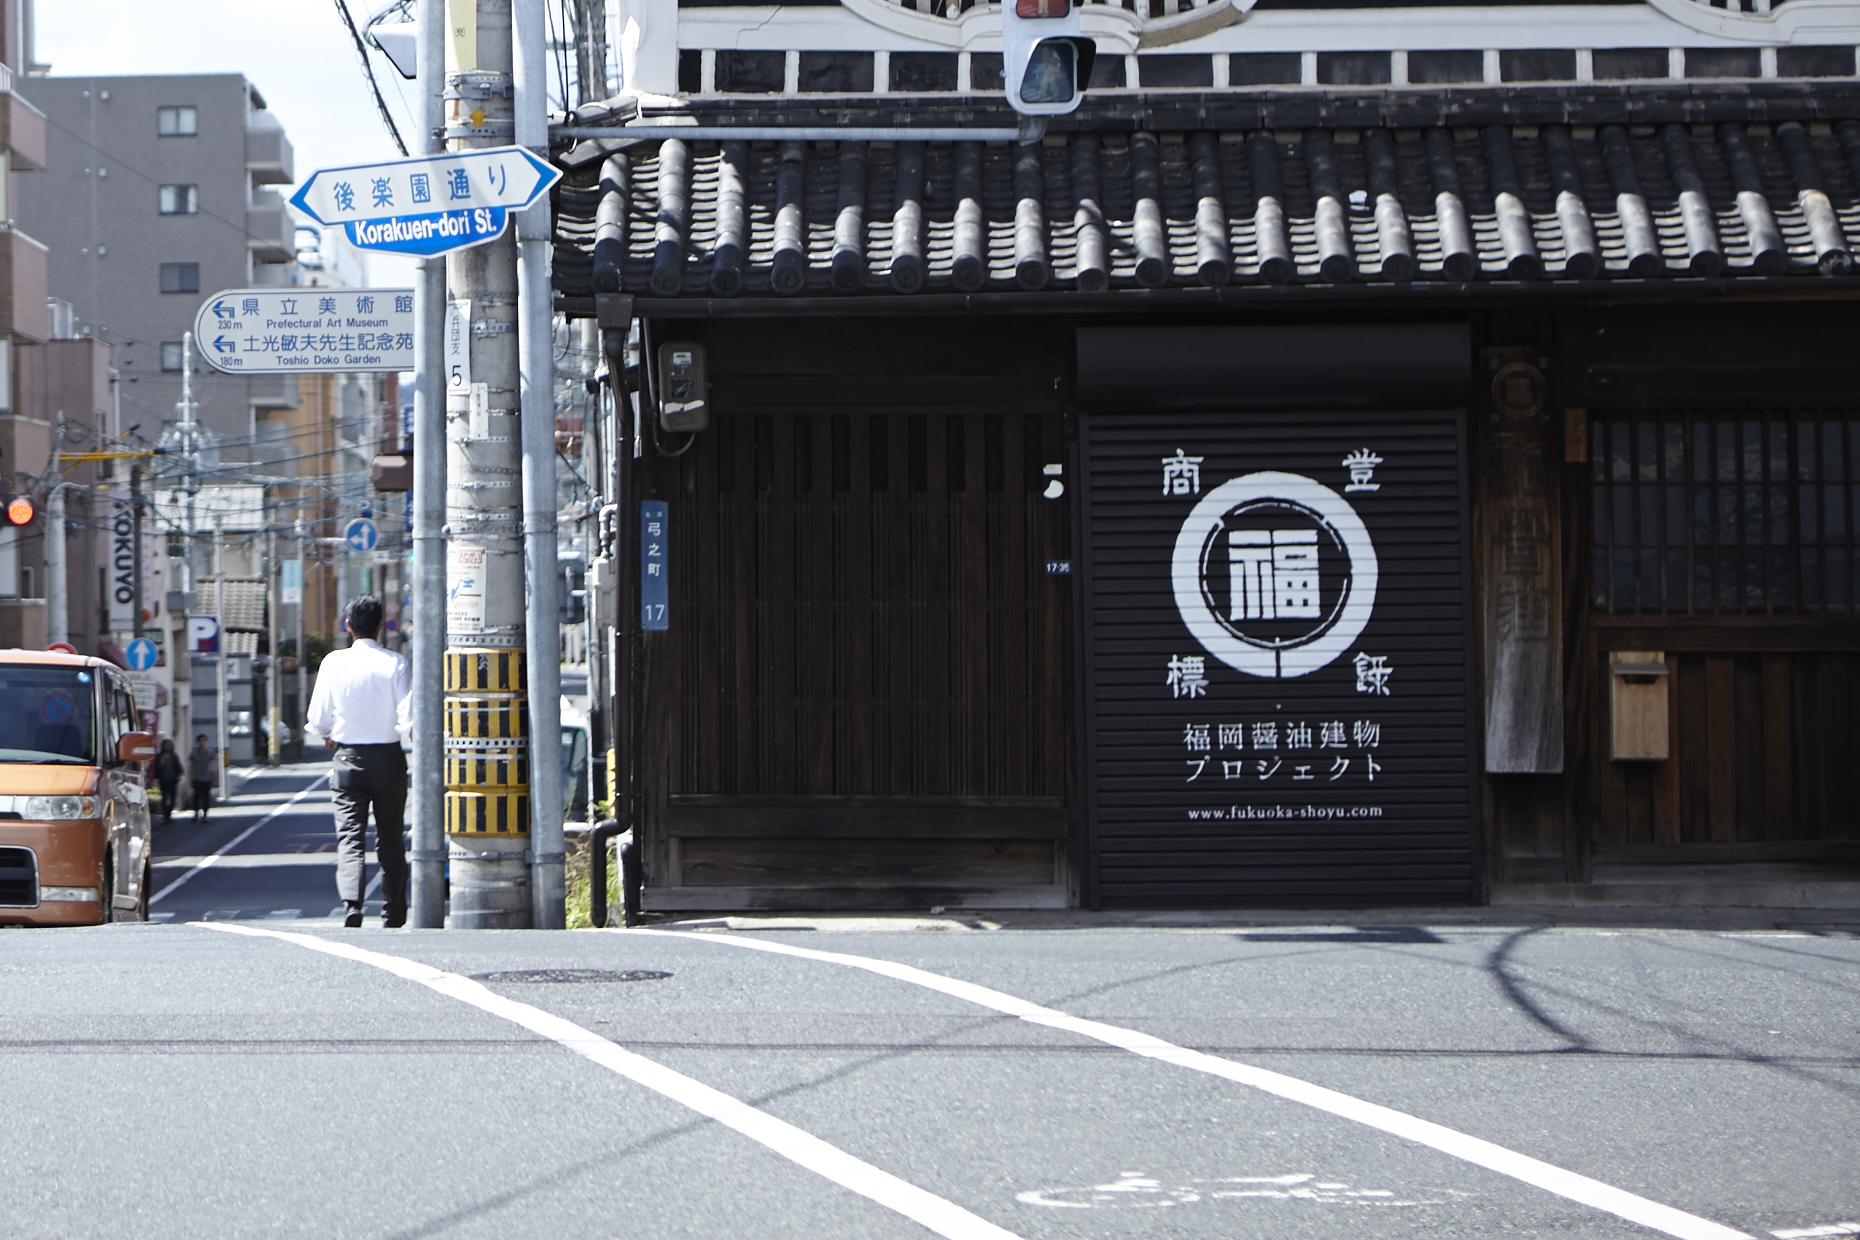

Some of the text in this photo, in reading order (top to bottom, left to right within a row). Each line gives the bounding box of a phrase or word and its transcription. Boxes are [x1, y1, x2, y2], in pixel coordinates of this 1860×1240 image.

[333, 164, 506, 211] 後楽園通り
[355, 208, 497, 245] Korakuen-dori St.
[242, 295, 413, 316] 県立美術館
[267, 318, 388, 328] Prefectural Art Museum
[243, 332, 414, 352] 土光敏夫先生記念苑
[276, 354, 381, 365] Toshio Doko Garden
[452, 365, 462, 386] 5
[648, 522, 661, 577] 弓之町
[645, 604, 665, 621] 17
[1183, 721, 1382, 752] 福岡醤油建物
[1185, 754, 1382, 783] プロジェクト
[1188, 805, 1383, 820] www.fukuoka-shoyu.com
